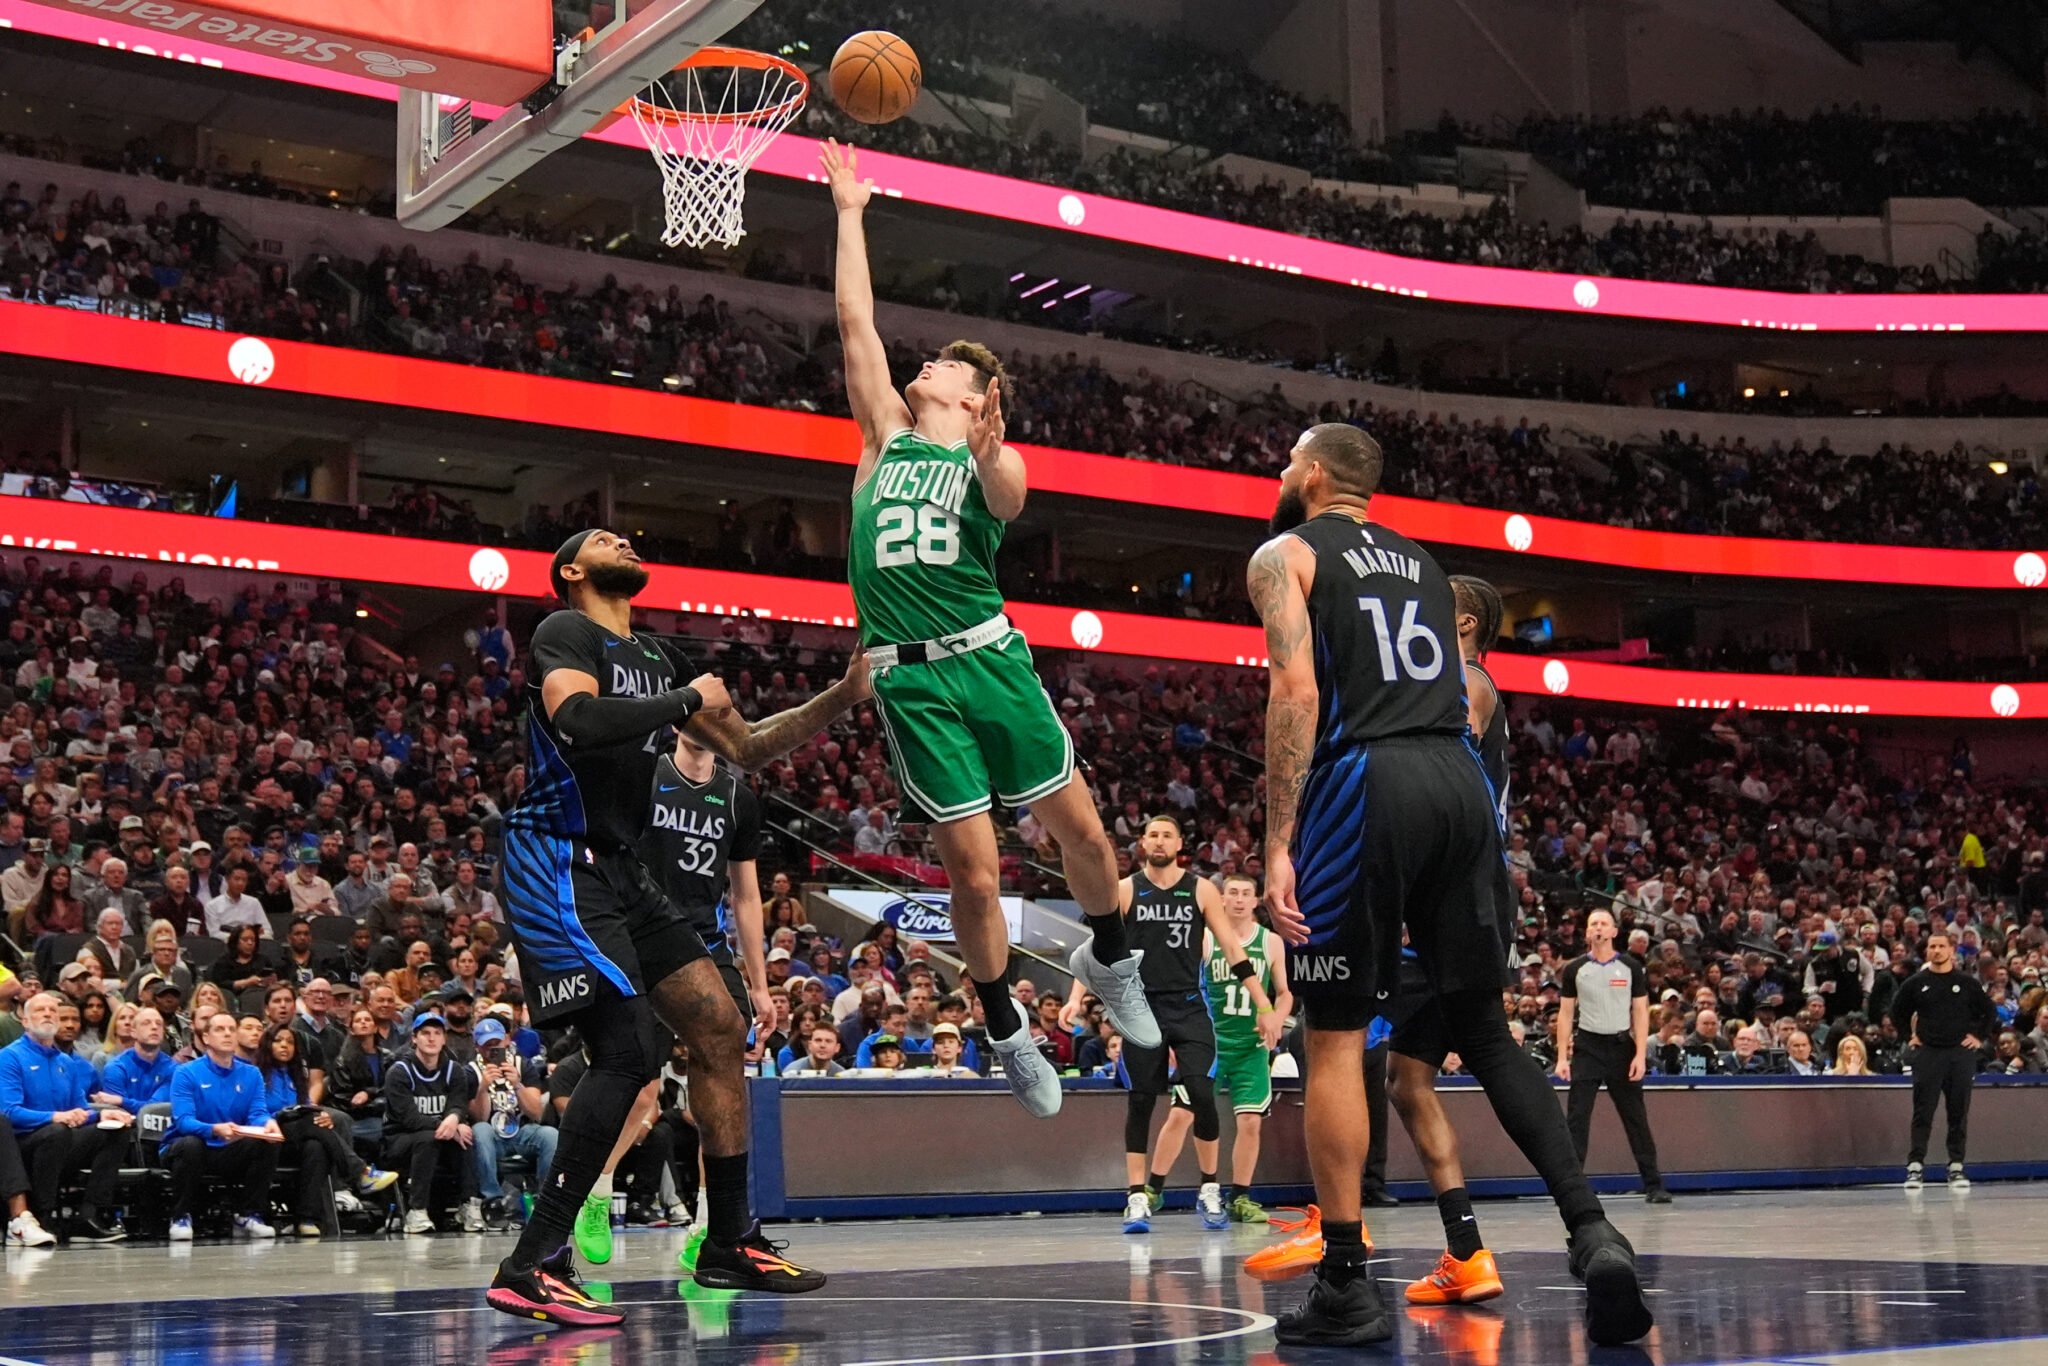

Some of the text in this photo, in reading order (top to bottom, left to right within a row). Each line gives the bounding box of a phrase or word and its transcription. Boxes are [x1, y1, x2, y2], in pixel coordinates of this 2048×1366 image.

[67, 0, 353, 62] StateFar
[871, 461, 973, 516] BOSTON
[875, 504, 960, 569] 28
[1342, 547, 1420, 584] MARTIN
[1358, 597, 1443, 681] 16
[704, 794, 725, 806] chime
[652, 803, 725, 840] DALLAS
[677, 836, 715, 877] 32
[1136, 904, 1193, 921] DALLAS
[1166, 923, 1192, 949] 31
[1293, 955, 1351, 982] MAVS
[538, 974, 590, 1008] MAVS
[1223, 985, 1252, 1016] 11
[143, 1114, 164, 1132] GET
